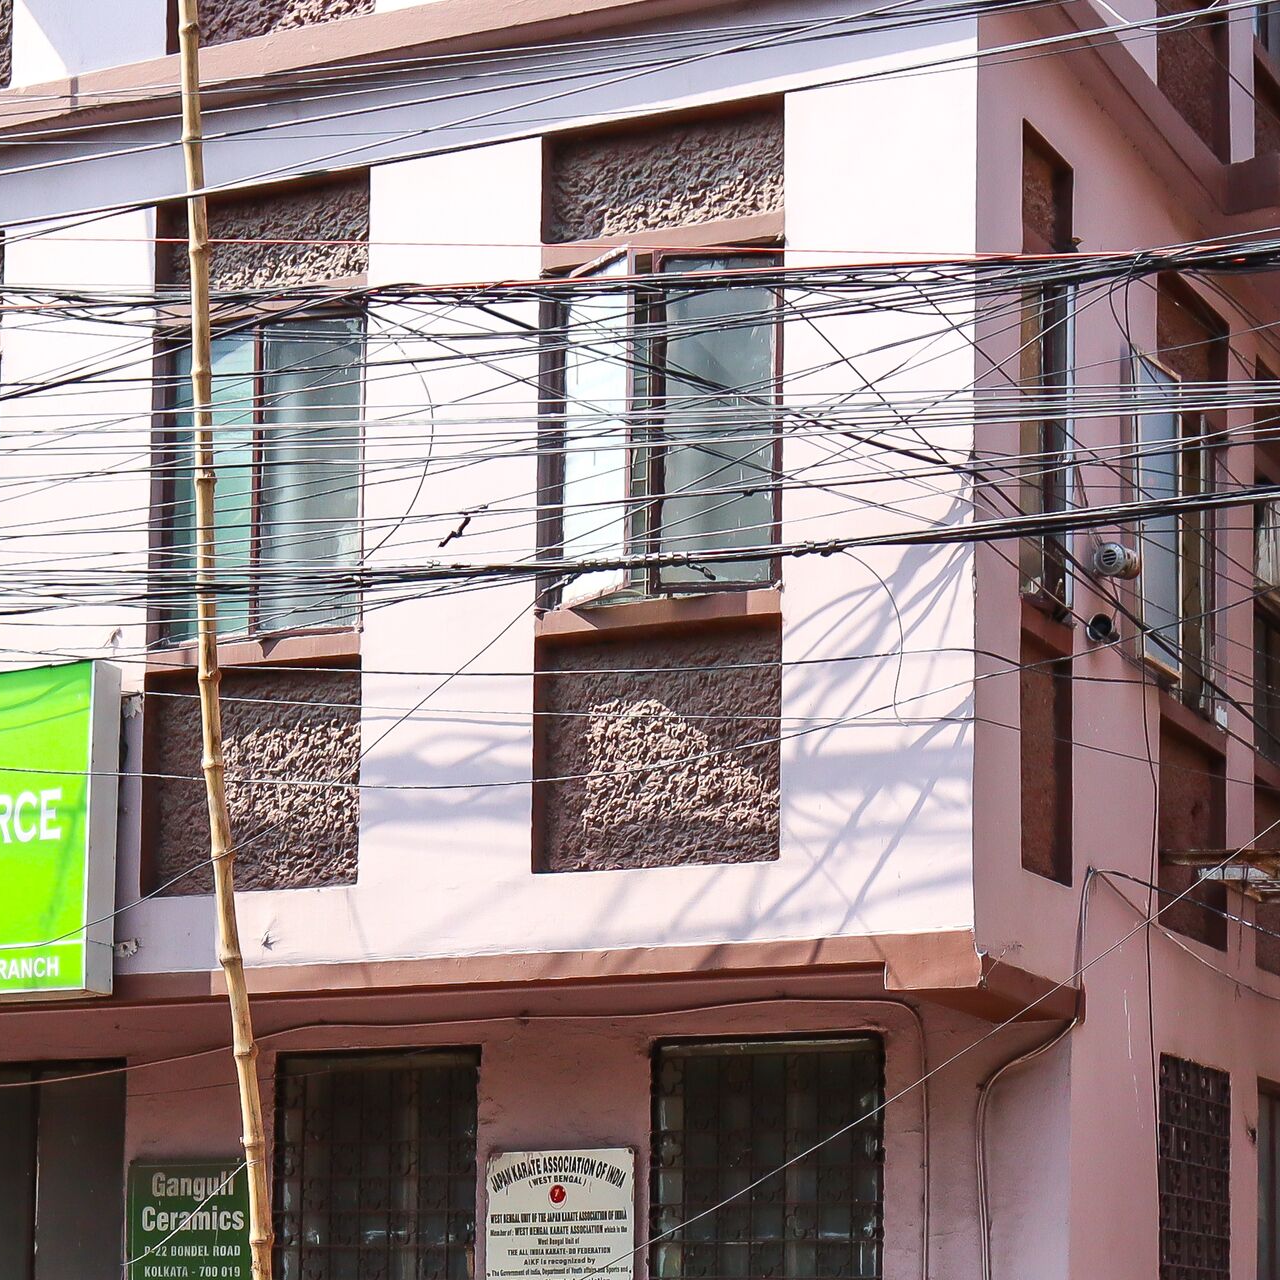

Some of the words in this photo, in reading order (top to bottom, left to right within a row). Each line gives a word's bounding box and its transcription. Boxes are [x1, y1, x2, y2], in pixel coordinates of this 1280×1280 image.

[490, 1167, 513, 1193] JAPAN
[510, 1158, 541, 1183] KARATE
[543, 1155, 596, 1176] ASSOCIATION
[595, 1160, 606, 1180] OF
[605, 1164, 627, 1189] INDIA
[152, 1170, 234, 1202] Ganguli
[142, 1205, 245, 1231] Ceramics
[570, 1224, 603, 1234] ASSOCIATION
[170, 1245, 209, 1257] BONDEL
[212, 1245, 241, 1257] ROAD
[548, 1257, 586, 1266] recognized
[587, 1256, 596, 1265] by
[144, 1266, 188, 1277] KOLKATA
[200, 1266, 218, 1277] 700
[221, 1266, 240, 1277] 019
